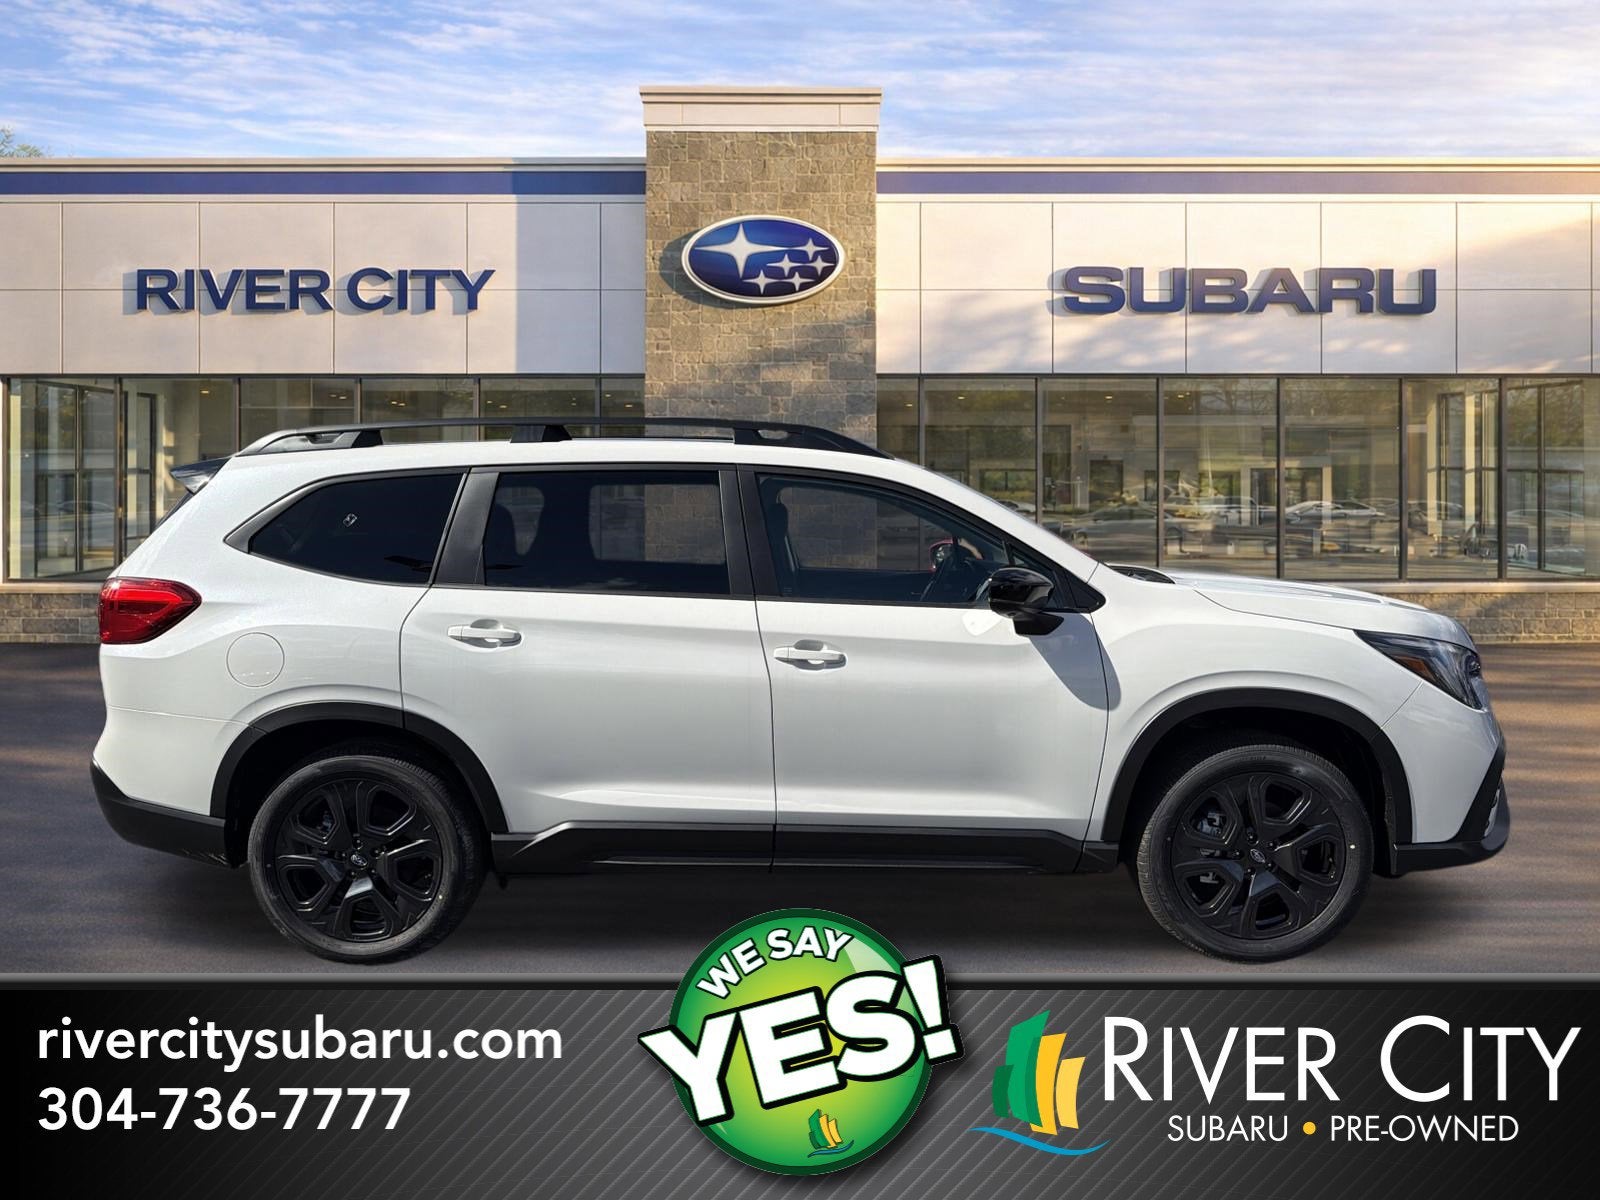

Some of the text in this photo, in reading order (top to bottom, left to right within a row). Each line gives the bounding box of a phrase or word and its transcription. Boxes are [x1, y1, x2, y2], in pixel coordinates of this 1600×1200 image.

[136, 266, 496, 312] RIVER CITY
[1063, 266, 1437, 315] SUBARU
